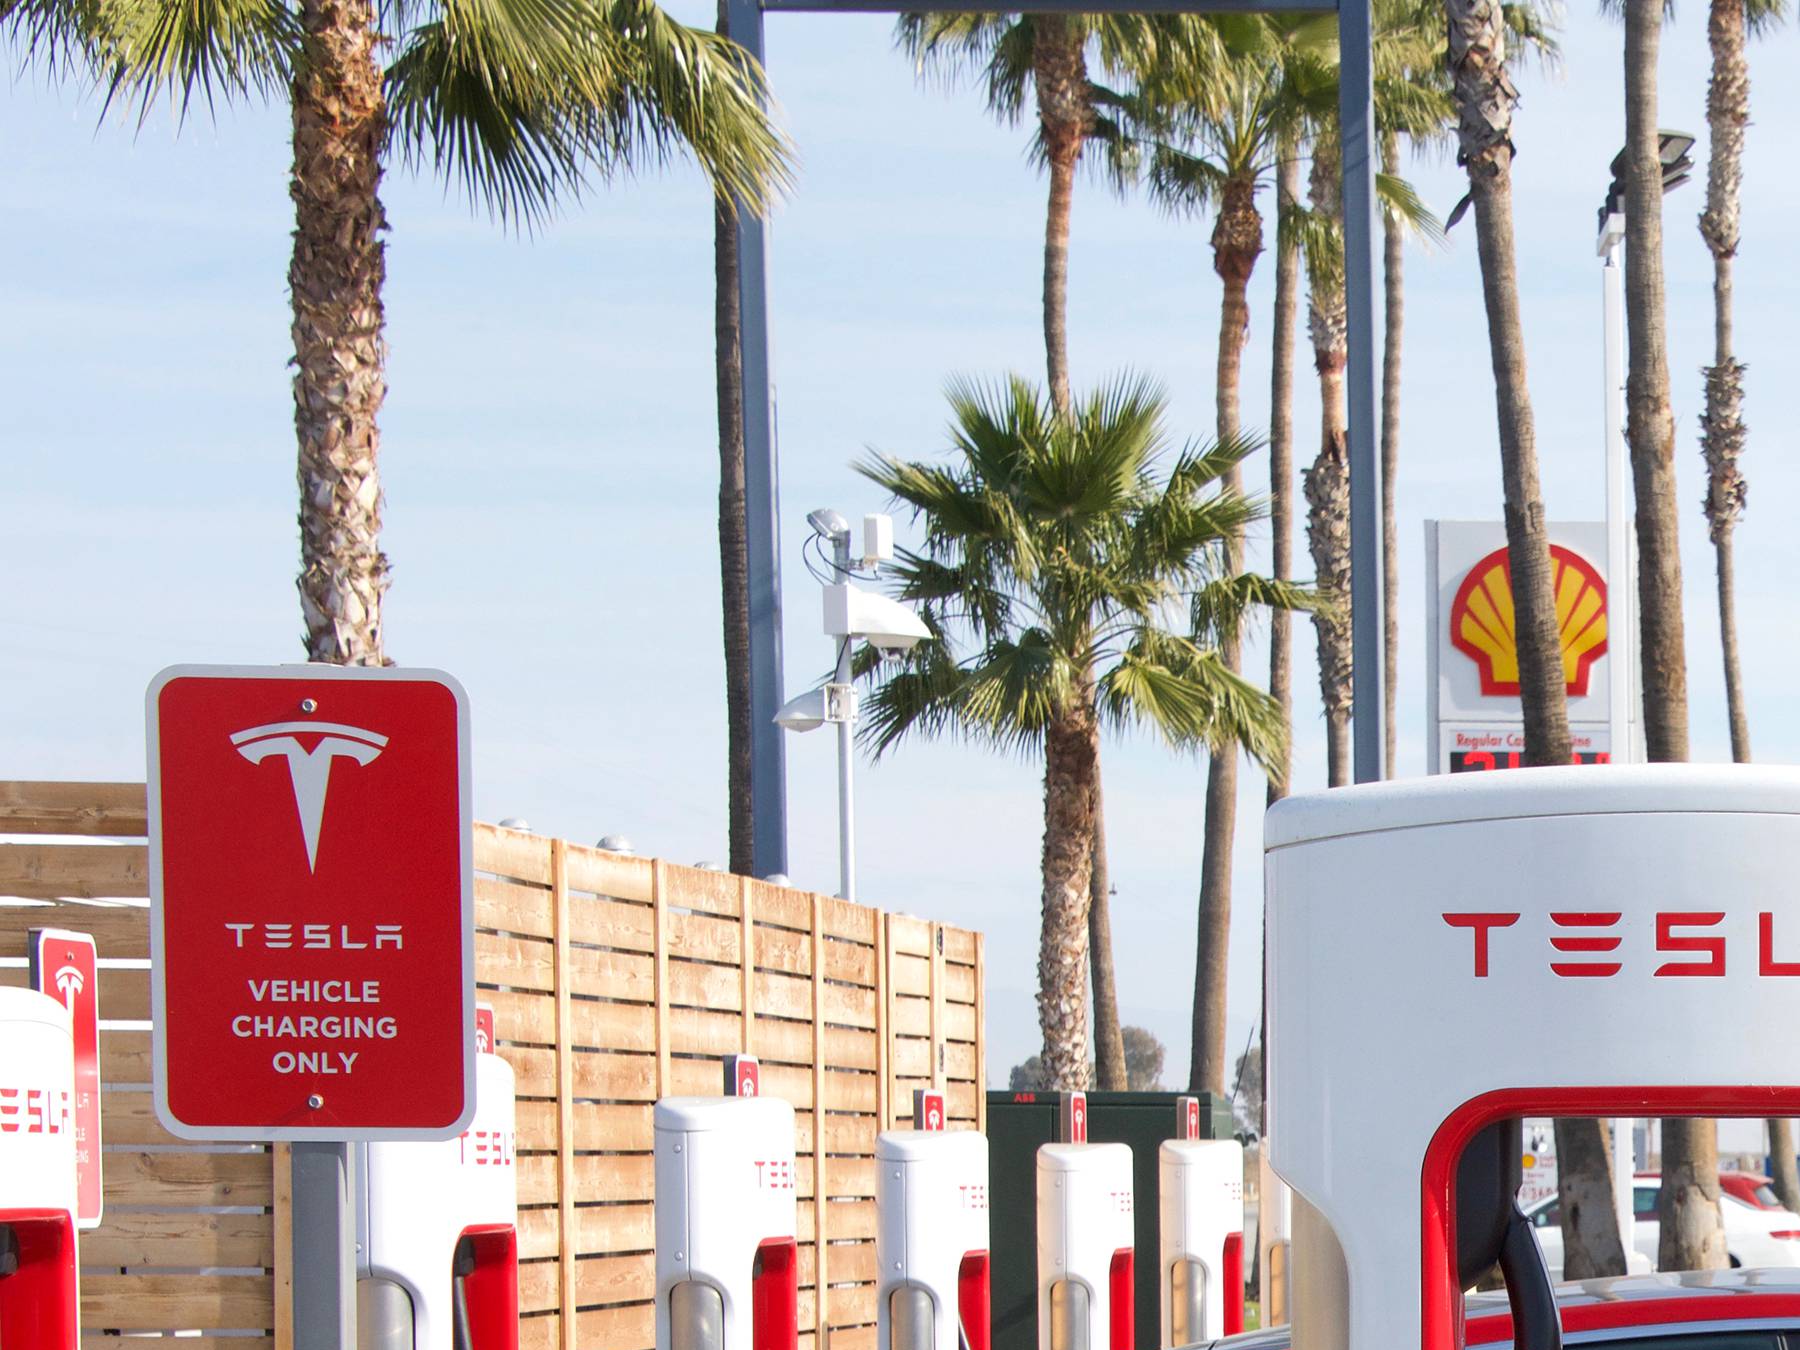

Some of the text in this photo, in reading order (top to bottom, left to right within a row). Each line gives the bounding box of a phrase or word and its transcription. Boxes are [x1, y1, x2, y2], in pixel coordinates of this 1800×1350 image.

[1456, 733, 1502, 750] Regular
[225, 923, 402, 949] TESLA
[248, 980, 380, 1003] VEHICLE
[231, 1015, 398, 1039] CHARGING
[272, 1051, 359, 1074] ONLY
